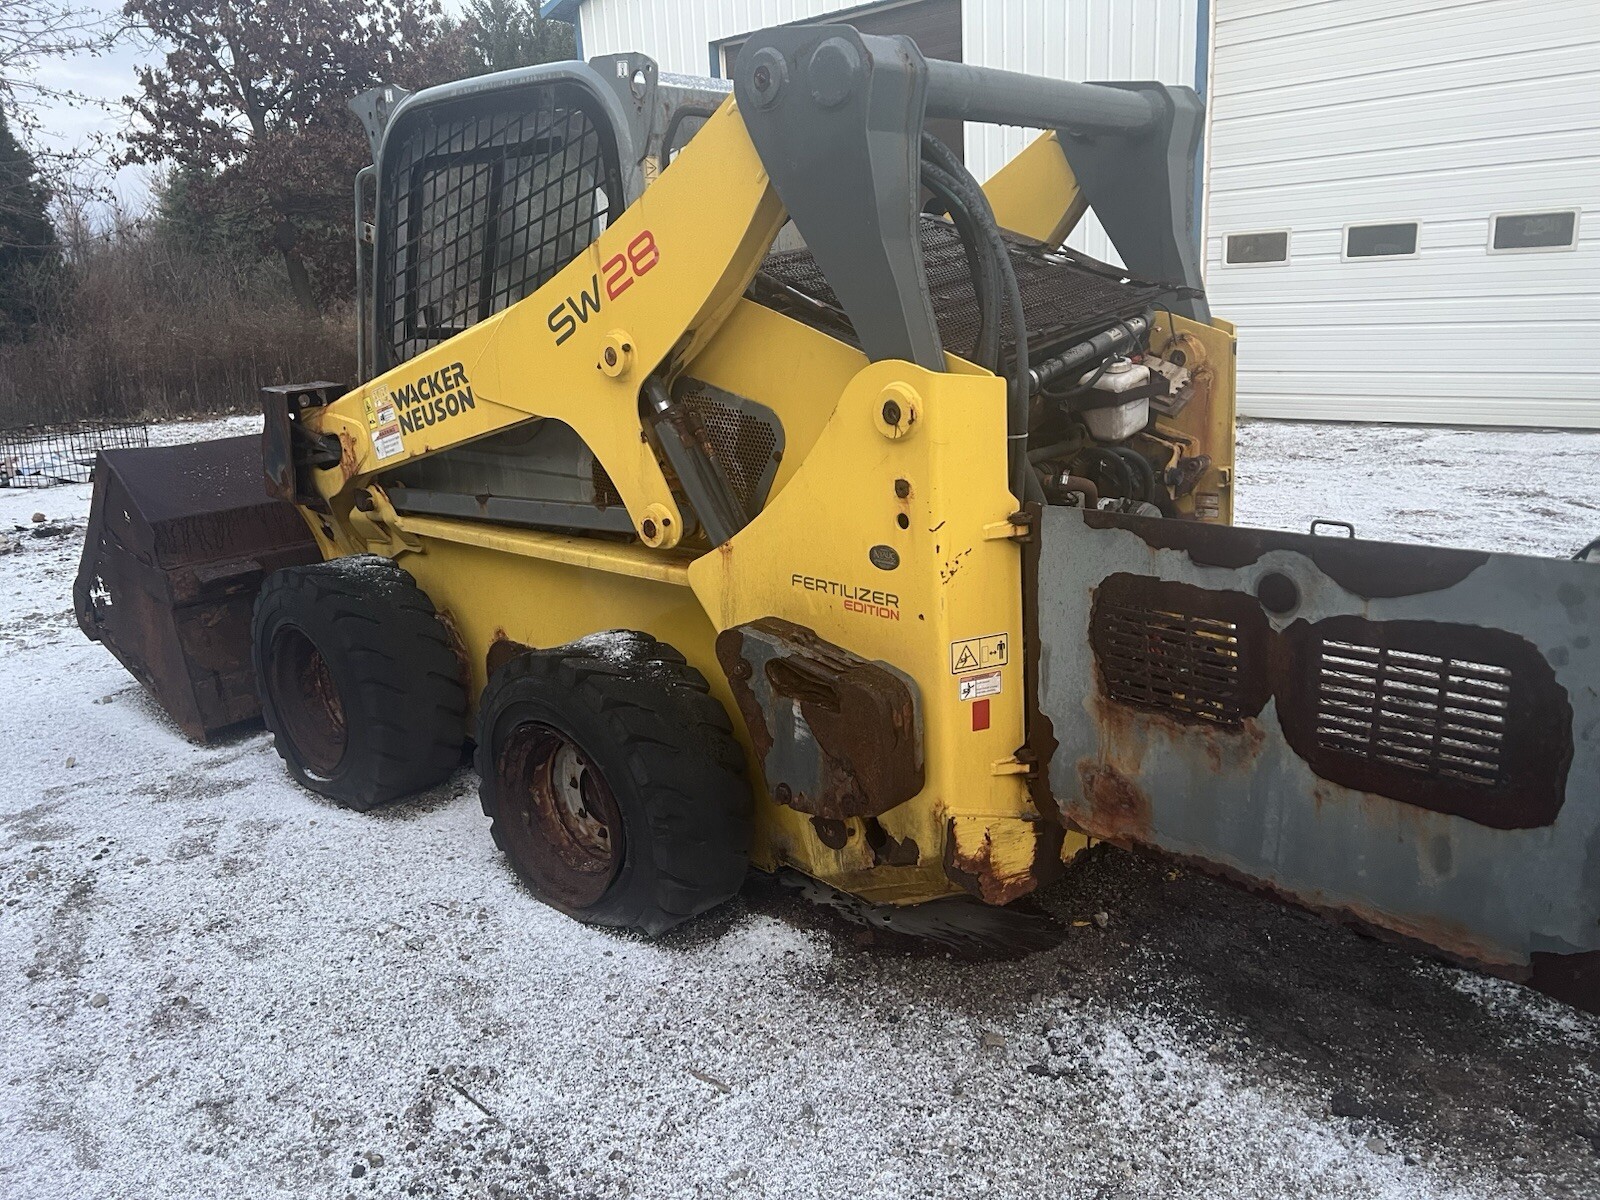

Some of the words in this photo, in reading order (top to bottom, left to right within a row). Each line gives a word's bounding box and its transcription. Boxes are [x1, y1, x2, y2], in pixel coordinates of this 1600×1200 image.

[548, 230, 660, 346] SW28
[390, 362, 469, 411] WACKER
[398, 386, 475, 436] NEUSON
[792, 574, 899, 608] FERTILIZER
[844, 600, 899, 621] EDITION
